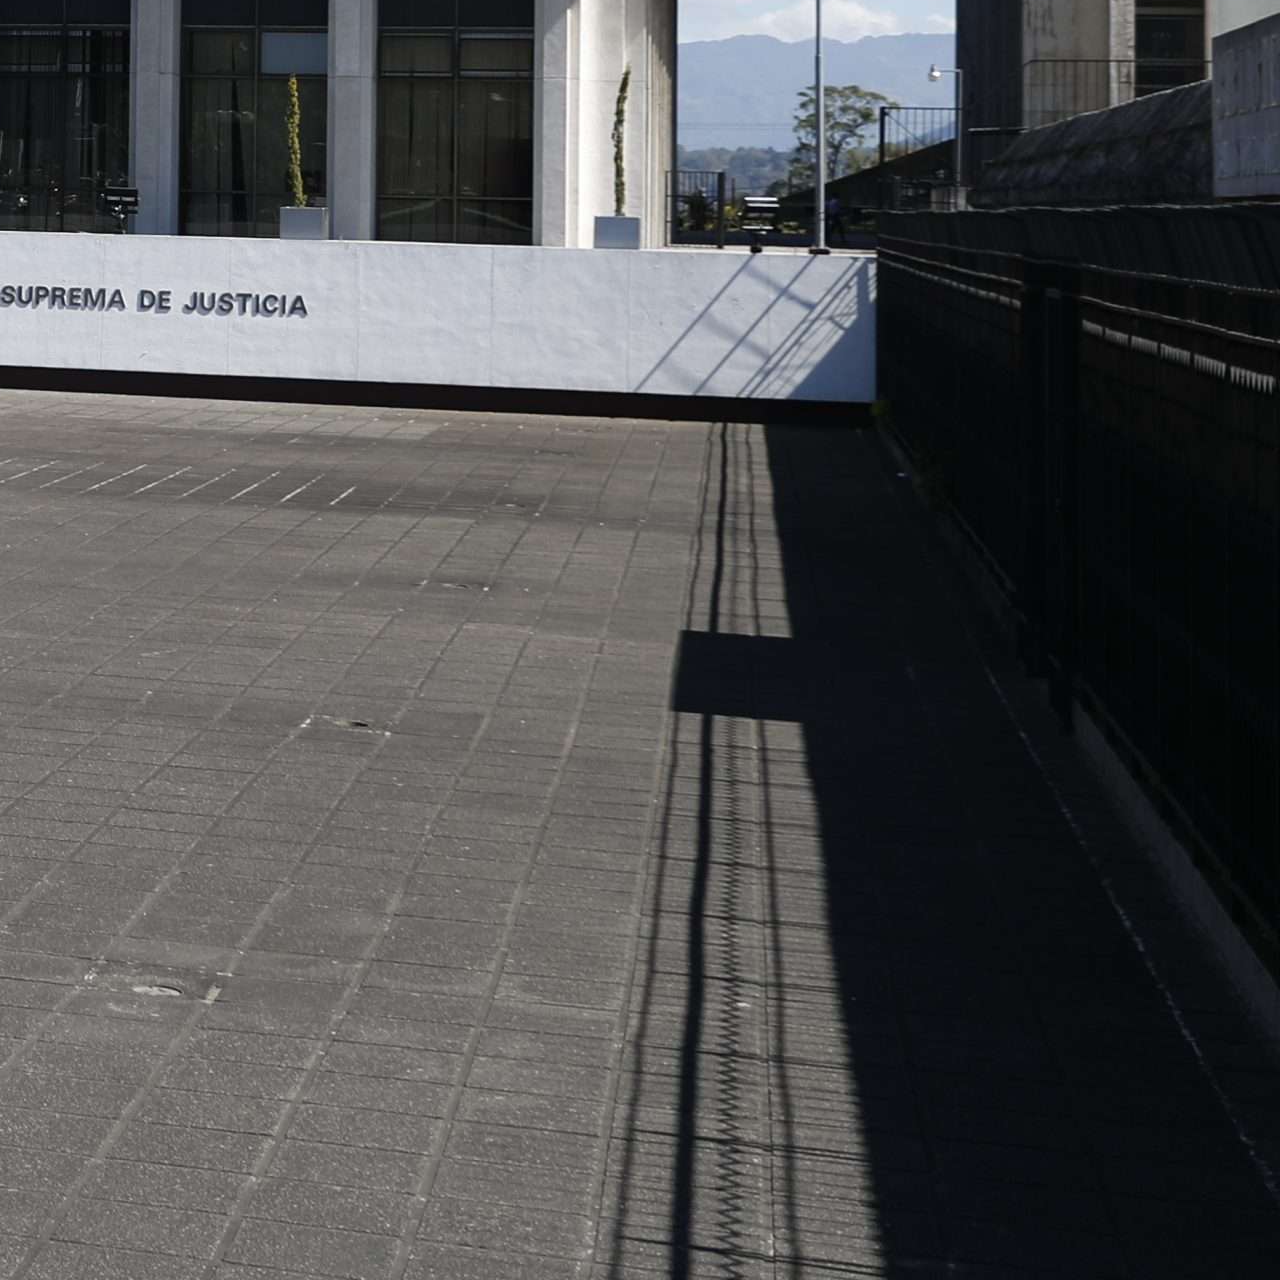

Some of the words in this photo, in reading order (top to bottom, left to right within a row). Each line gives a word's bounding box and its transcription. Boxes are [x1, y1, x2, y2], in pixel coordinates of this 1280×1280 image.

[0, 284, 127, 310] SUPREMA
[139, 289, 172, 311] DE
[183, 291, 309, 316] JUSTICIA
